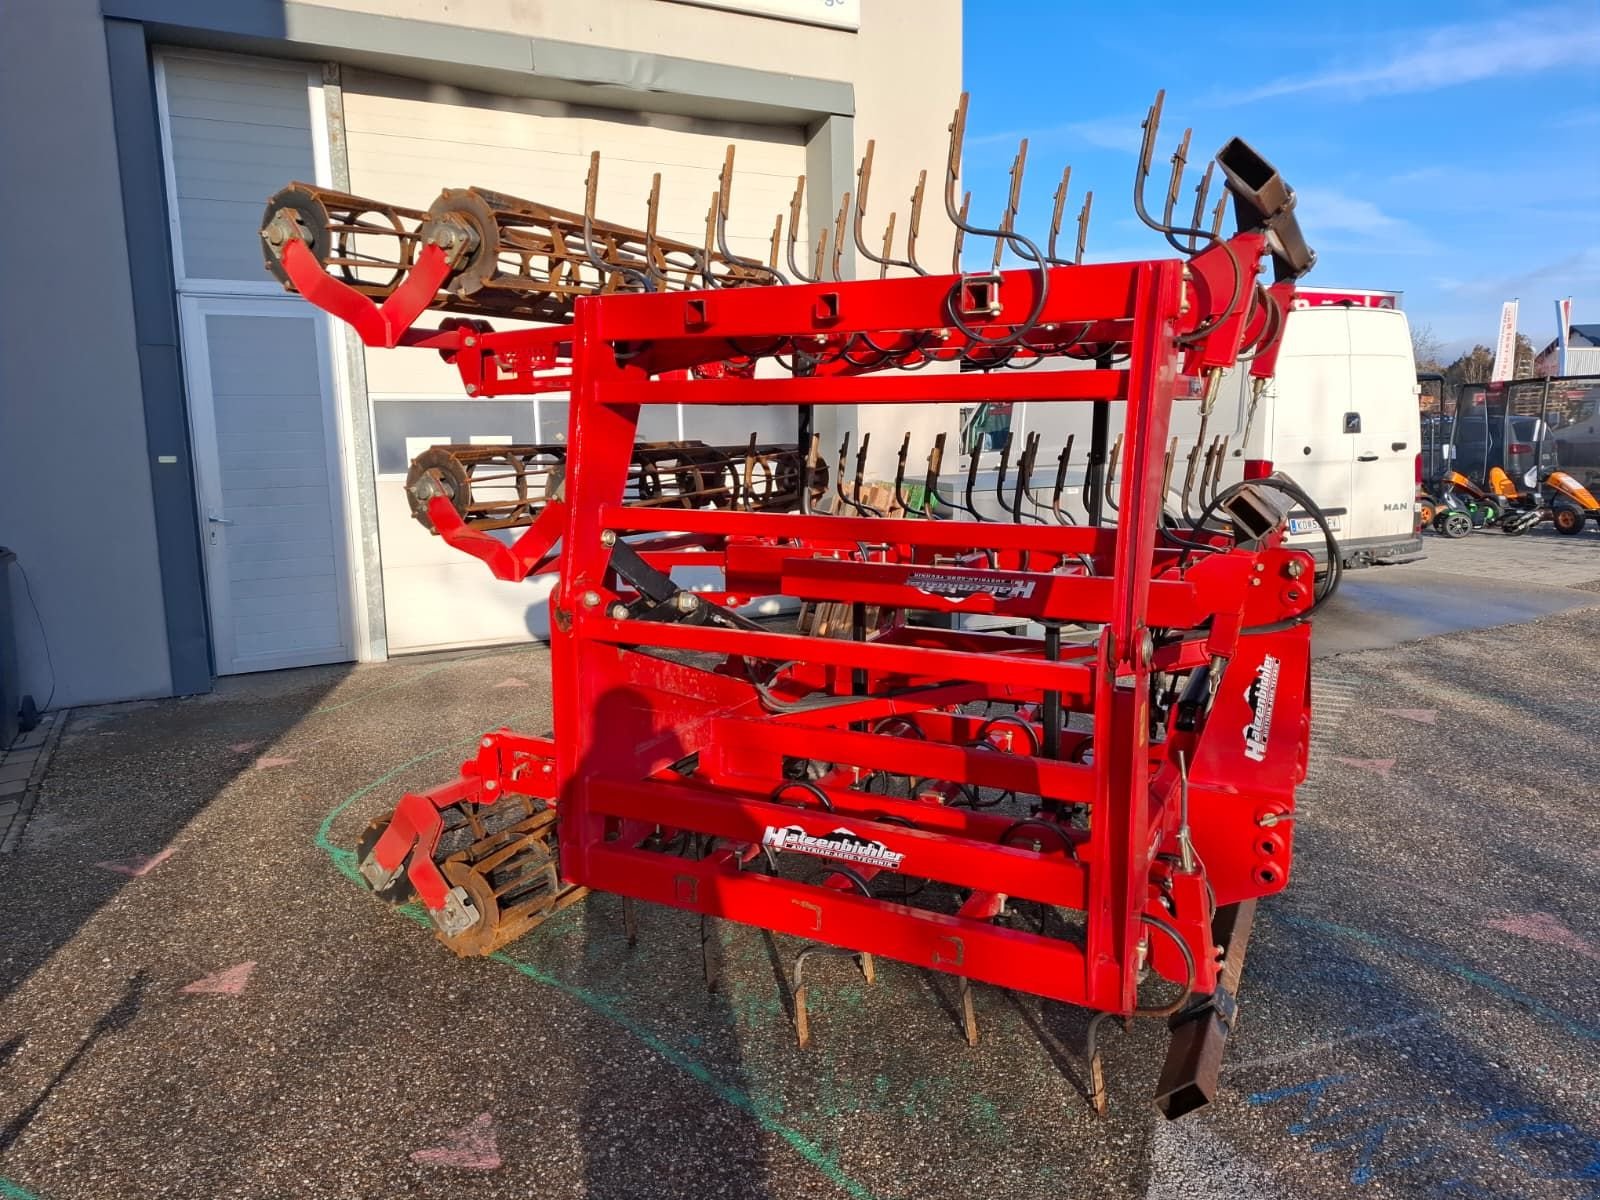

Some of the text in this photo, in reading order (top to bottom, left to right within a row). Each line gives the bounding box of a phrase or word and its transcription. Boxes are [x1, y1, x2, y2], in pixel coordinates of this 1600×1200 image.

[1383, 502, 1408, 512] MAN
[1244, 653, 1274, 762] Hatzenbichler
[762, 826, 906, 862] Hatzenbichler
